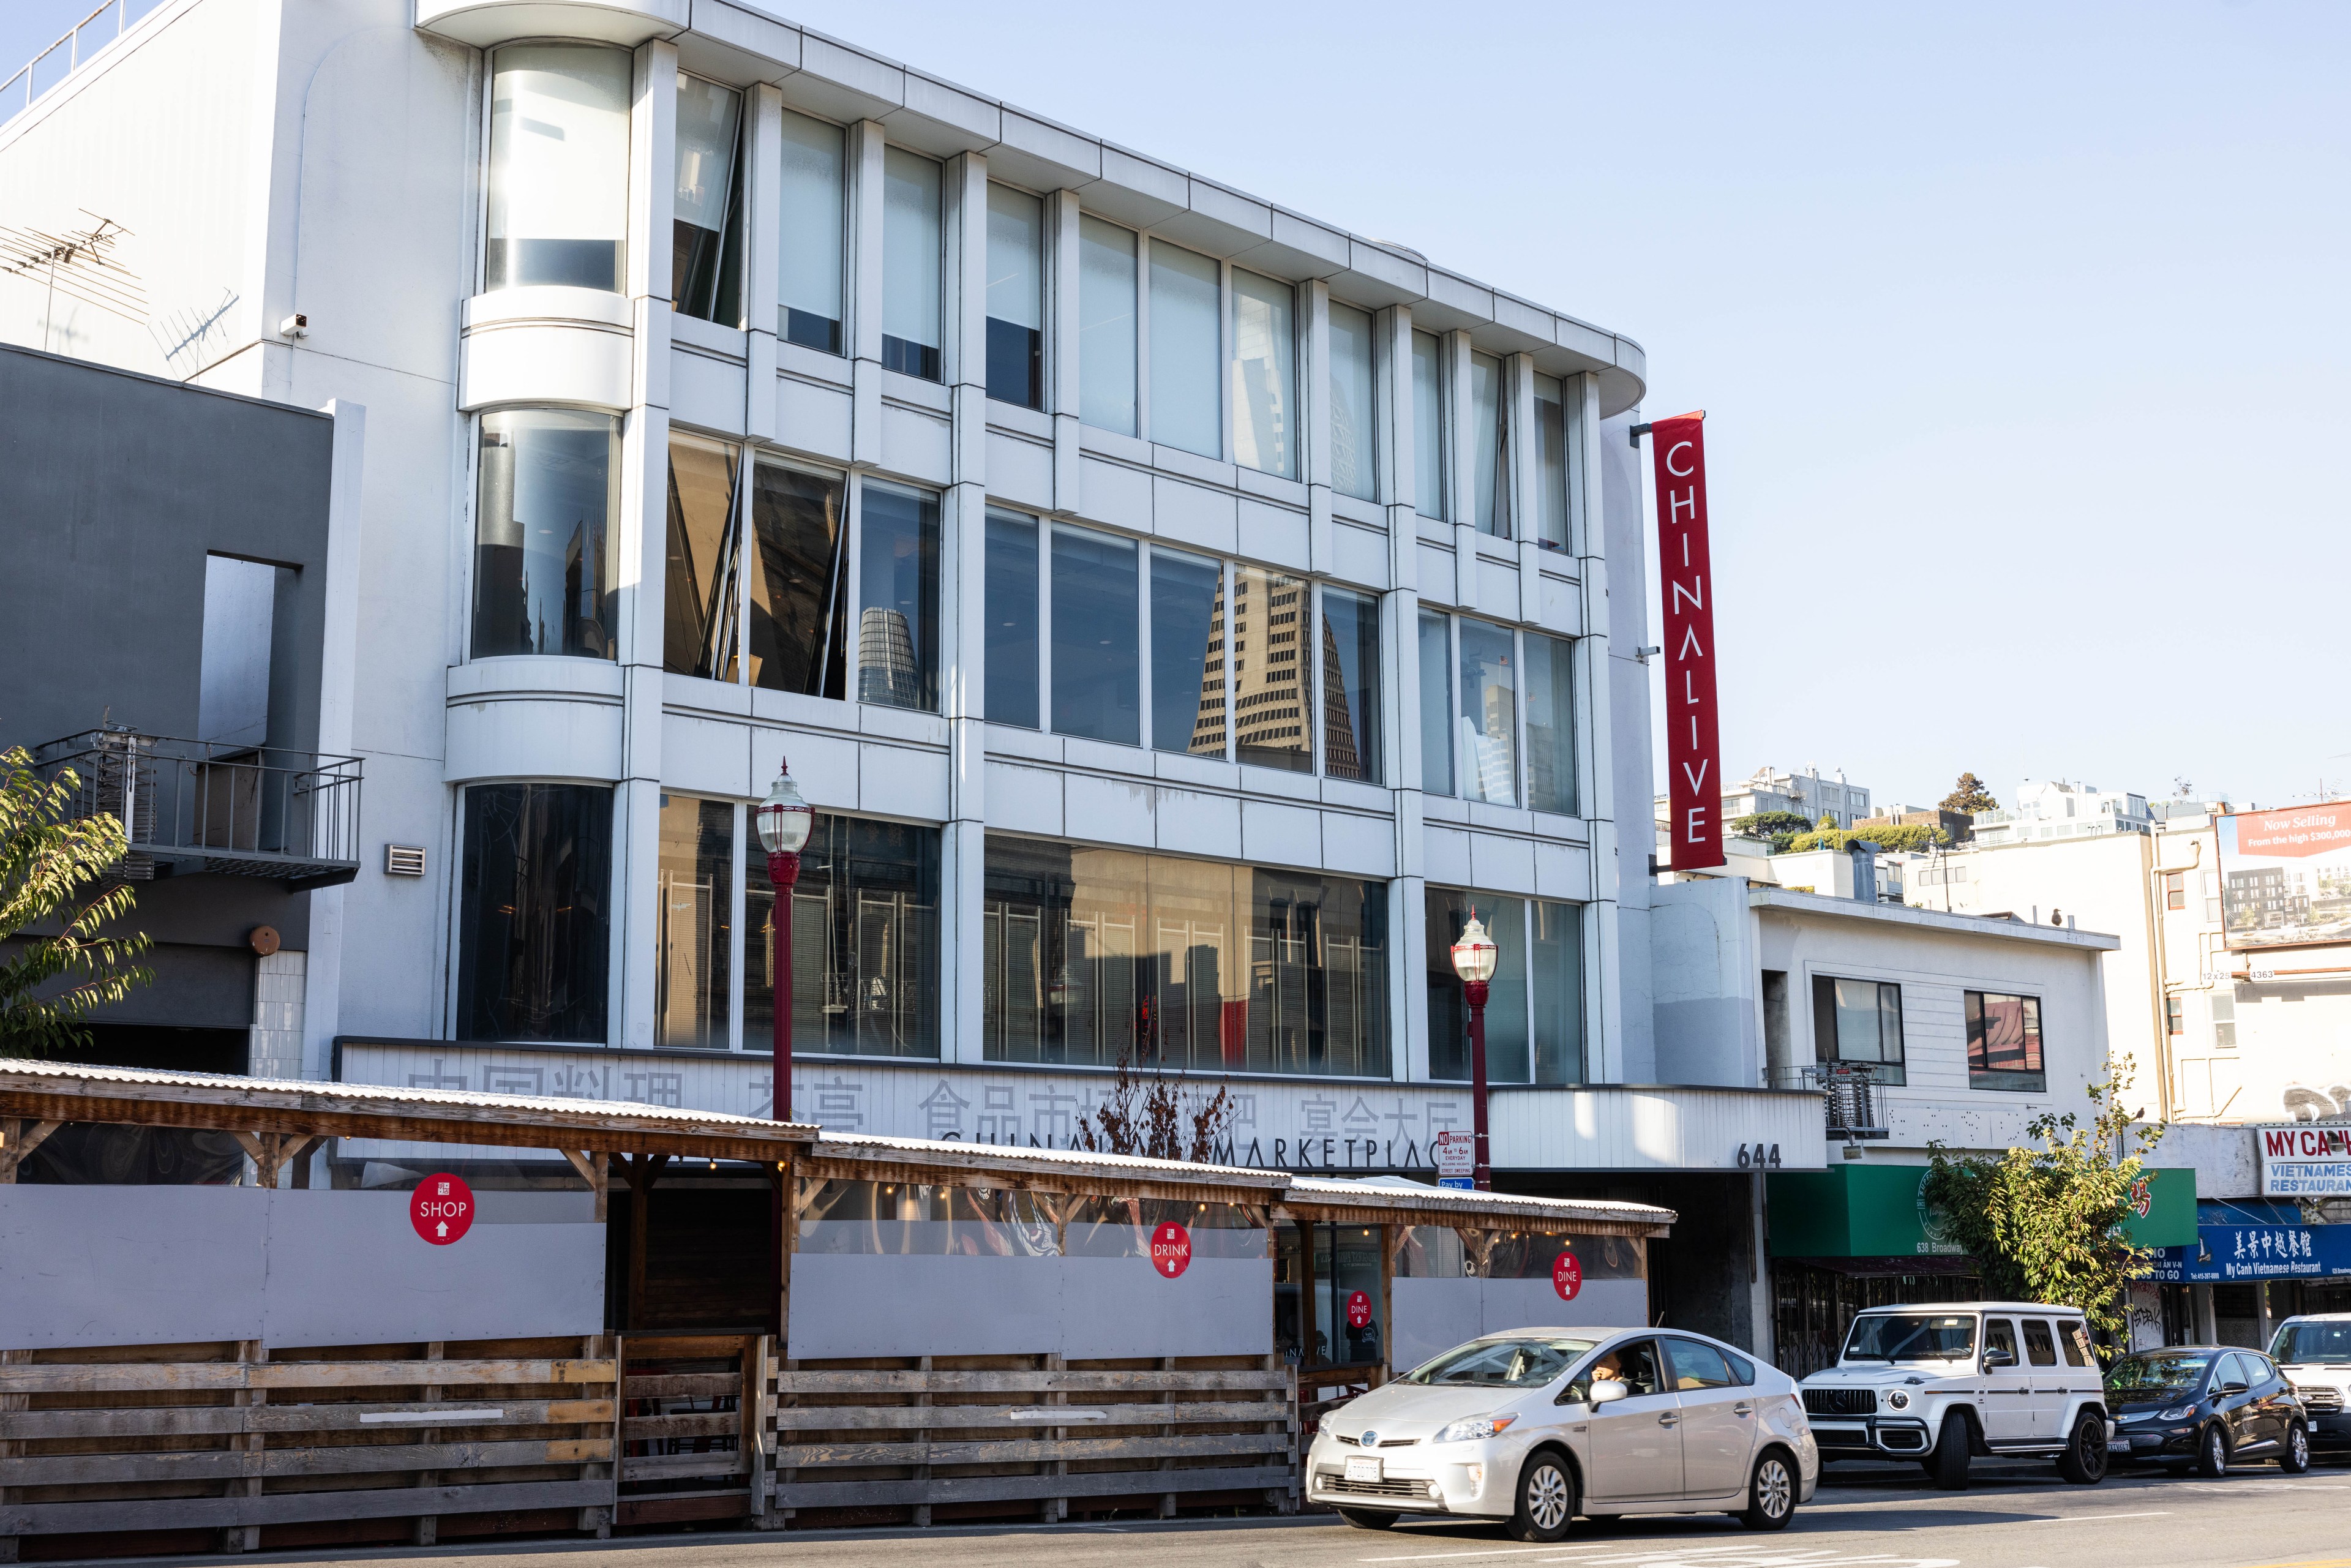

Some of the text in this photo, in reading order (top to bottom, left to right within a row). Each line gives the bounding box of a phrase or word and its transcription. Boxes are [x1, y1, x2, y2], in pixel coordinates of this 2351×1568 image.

[2263, 814, 2336, 831] Now Selling
[2248, 838, 2270, 847] From
[2289, 833, 2309, 844] high
[1439, 1133, 1471, 1144] NO PARKING
[2265, 1131, 2295, 1157] MY
[1737, 1143, 1782, 1168] 644
[1455, 1180, 1463, 1189] by
[420, 1201, 467, 1217] SHOP
[1155, 1244, 1188, 1256] DRINK
[1917, 1242, 1963, 1255] 638 Broadway
[1558, 1271, 1577, 1281] DINE
[2155, 1270, 2165, 1280] TO
[2168, 1270, 2180, 1280] GO
[2225, 1261, 2321, 1278] My Canh Vietnamese Restaurant
